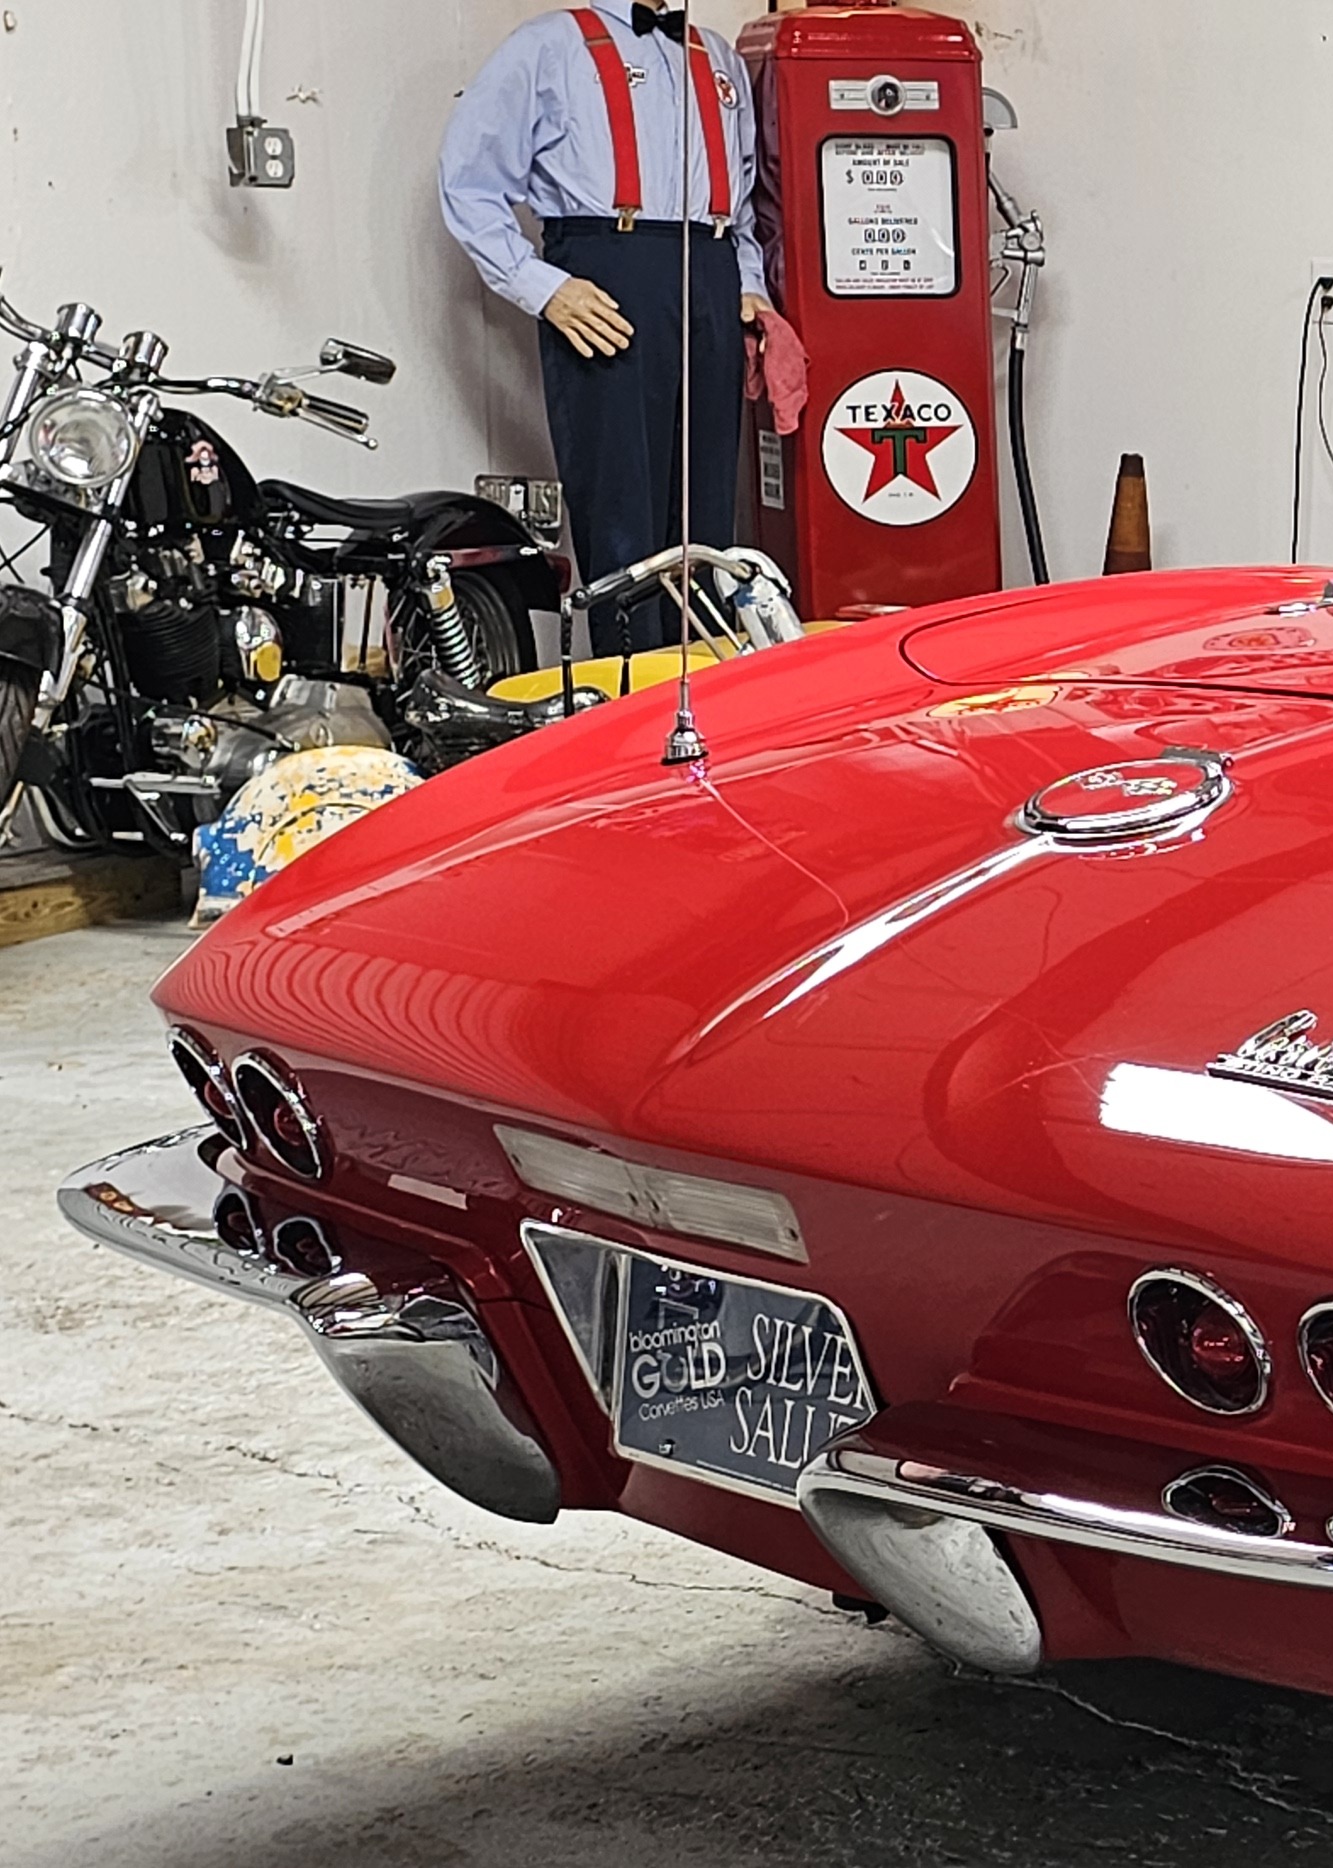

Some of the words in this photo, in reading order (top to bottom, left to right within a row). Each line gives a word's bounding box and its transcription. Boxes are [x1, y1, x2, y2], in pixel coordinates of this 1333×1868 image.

[846, 402, 952, 424] TEXACO
[628, 1319, 721, 1358] bloomington
[700, 1389, 725, 1409] USA
